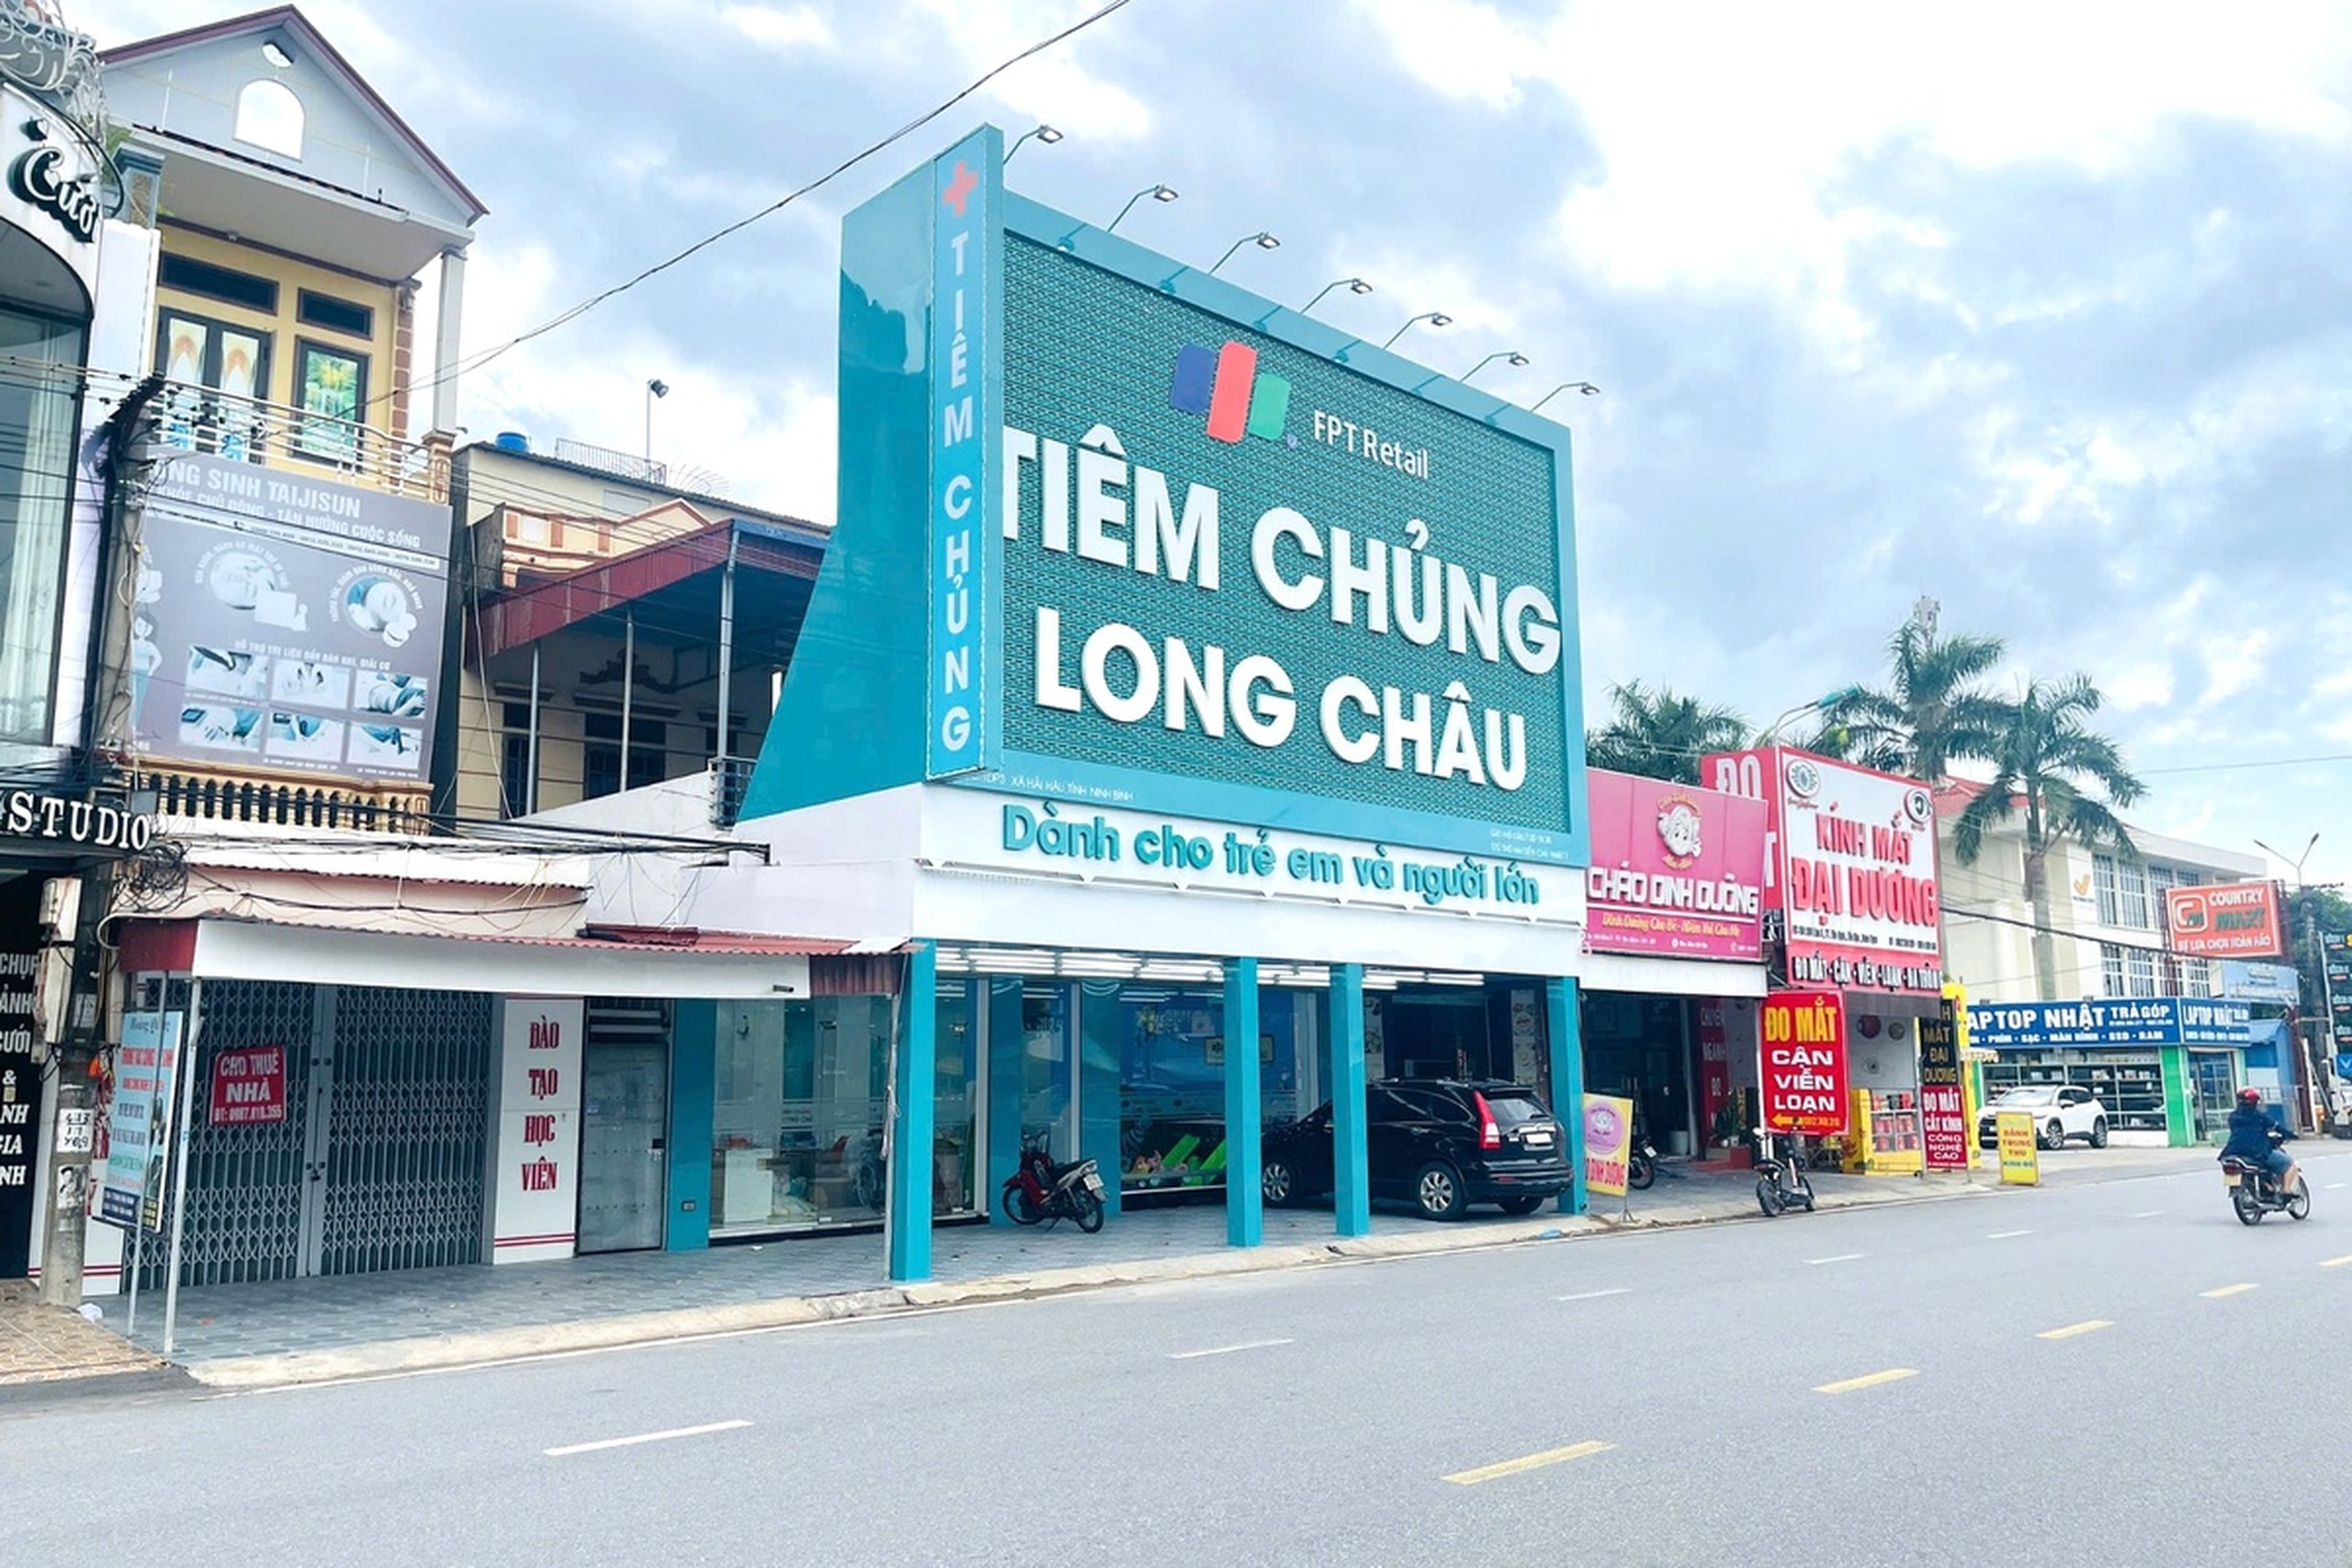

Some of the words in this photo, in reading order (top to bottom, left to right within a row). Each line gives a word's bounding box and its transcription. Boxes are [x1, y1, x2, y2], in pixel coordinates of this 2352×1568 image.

[944, 231, 975, 448] TIÊM
[1313, 409, 1357, 453] FPT
[1363, 427, 1429, 480] Retail
[207, 467, 261, 499] SINH
[266, 479, 361, 519] TAIJISUN
[1002, 423, 1220, 592] TIÊM
[1250, 505, 1561, 675] CHỦNG
[941, 473, 974, 753] CHỦNG
[1035, 605, 1297, 748] LONG
[1319, 680, 1527, 792] CHÂU
[7, 790, 150, 851] STUDIO
[1815, 801, 1866, 858] KÍNH
[1872, 810, 1914, 866] MẮT
[1001, 800, 1121, 862] Dành
[1134, 824, 1214, 870] cho
[1224, 828, 1277, 876] trẻ
[1287, 847, 1343, 885] em
[1351, 843, 1395, 890] và
[1403, 855, 1488, 905] người
[1494, 861, 1540, 905] lớn
[1588, 859, 1647, 903] CHÁO
[1649, 873, 1694, 908] DINH
[1695, 873, 1759, 915] DƯỠNG
[1790, 855, 1843, 925] ĐẠI
[1849, 865, 1939, 928] DƯƠNG
[2207, 888, 2266, 908] COUNTRY
[528, 1014, 560, 1049] ĐÀO
[1765, 1007, 1791, 1043] ĐO
[1794, 995, 1838, 1043] MẮT
[1967, 1010, 2037, 1030] APTOP
[2044, 1002, 2105, 1031] NHẬT
[2110, 1001, 2139, 1019] TRẢ
[2142, 1003, 2170, 1019] GÓP
[0, 1023, 31, 1055] ƯỚI
[220, 1055, 247, 1077] CHO
[249, 1047, 279, 1076] THUÊ
[1771, 1045, 1834, 1069] CẬN
[3, 1068, 17, 1085] &
[225, 1077, 271, 1104] NHÀ
[527, 1067, 559, 1100] TẠO
[1773, 1066, 1834, 1091] VIỄN
[1774, 1094, 1836, 1114] LOẠN
[523, 1113, 557, 1147] HỌC
[521, 1156, 558, 1191] VIÊN
[1933, 1152, 1959, 1160] CAO
